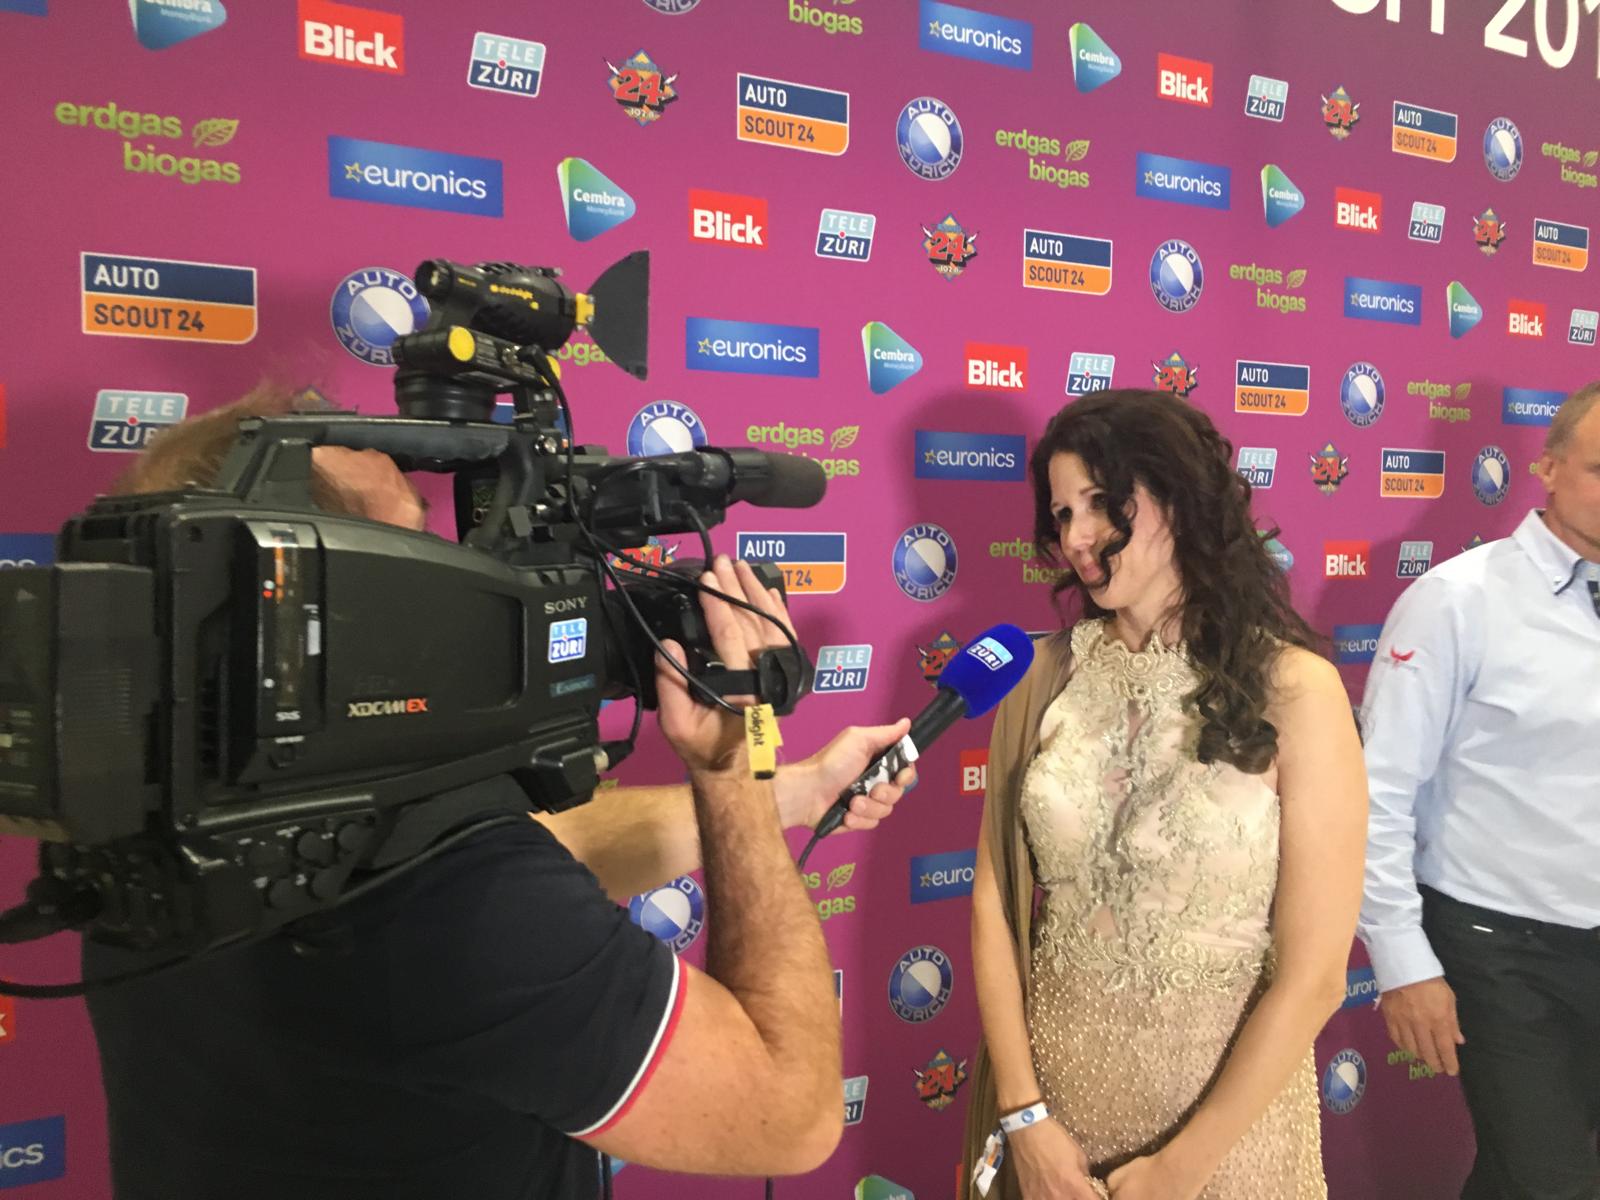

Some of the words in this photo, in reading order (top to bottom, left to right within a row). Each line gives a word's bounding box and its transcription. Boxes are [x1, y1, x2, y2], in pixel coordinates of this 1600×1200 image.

[788, 0, 863, 35] biogas
[304, 20, 397, 68] Blick
[483, 39, 536, 63] TELE
[942, 23, 1022, 55] euronics
[1079, 48, 1115, 66] Cembra
[614, 69, 663, 106] 24
[745, 83, 787, 107] AUTO
[1160, 69, 1208, 103] Blick
[54, 101, 182, 138] erdgas
[908, 99, 954, 126] AUTO
[1397, 109, 1422, 127] AUTO
[745, 115, 793, 140] SCOUT
[797, 125, 815, 143] 24
[995, 129, 1060, 155] erdgas
[1396, 132, 1427, 151] SCOUT
[1426, 138, 1437, 153] 24
[1541, 142, 1581, 163] erdgas
[124, 142, 241, 184] biogas
[1029, 158, 1089, 188] biogas
[363, 163, 487, 199] euronics
[1154, 171, 1221, 197] euronics
[1560, 165, 1598, 188] biogas
[573, 188, 626, 208] Cembra
[693, 208, 763, 246] Blick
[828, 214, 868, 233] TELE
[1336, 202, 1378, 230] Blick
[1538, 225, 1558, 241] AUTO
[929, 231, 965, 262] 24
[1029, 237, 1063, 257] AUTO
[1159, 242, 1196, 264] AUTO
[94, 264, 159, 290] AUTO
[347, 271, 418, 301] AUTO
[1029, 265, 1070, 285] SCOUT
[1071, 270, 1085, 286] 24
[1229, 263, 1282, 286] erdgas
[1256, 288, 1306, 313] biogas
[1359, 292, 1414, 314] euronics
[94, 303, 173, 329] SCOUT
[178, 310, 205, 332] 24
[1509, 312, 1543, 337] Blick
[713, 338, 806, 363] euronics
[874, 348, 914, 362] Cembra
[968, 359, 1023, 389] Blick
[1075, 357, 1109, 372] TELE
[1240, 367, 1268, 383] AUTO
[1159, 366, 1188, 392] 24
[1407, 379, 1451, 400] erdgas
[107, 396, 176, 417] TELE
[1240, 392, 1273, 408] SCOUT
[1275, 395, 1286, 408] 24
[641, 403, 697, 428] AUTO
[1429, 402, 1471, 423] biogas
[747, 422, 824, 448] erdgas
[936, 447, 1015, 468] euronics
[1386, 455, 1410, 470] AUTO
[1384, 477, 1414, 492] SCOUT
[1414, 479, 1425, 492] 24
[904, 526, 949, 547] AUTO
[745, 540, 786, 558] AUTO
[989, 537, 1037, 561] erdg
[1325, 554, 1366, 576] Blick
[796, 570, 813, 586] 24
[544, 597, 587, 614] SONY
[825, 650, 865, 664] TELE
[932, 866, 974, 887] euro
[817, 895, 856, 920] gas
[899, 948, 945, 974] AUTO
